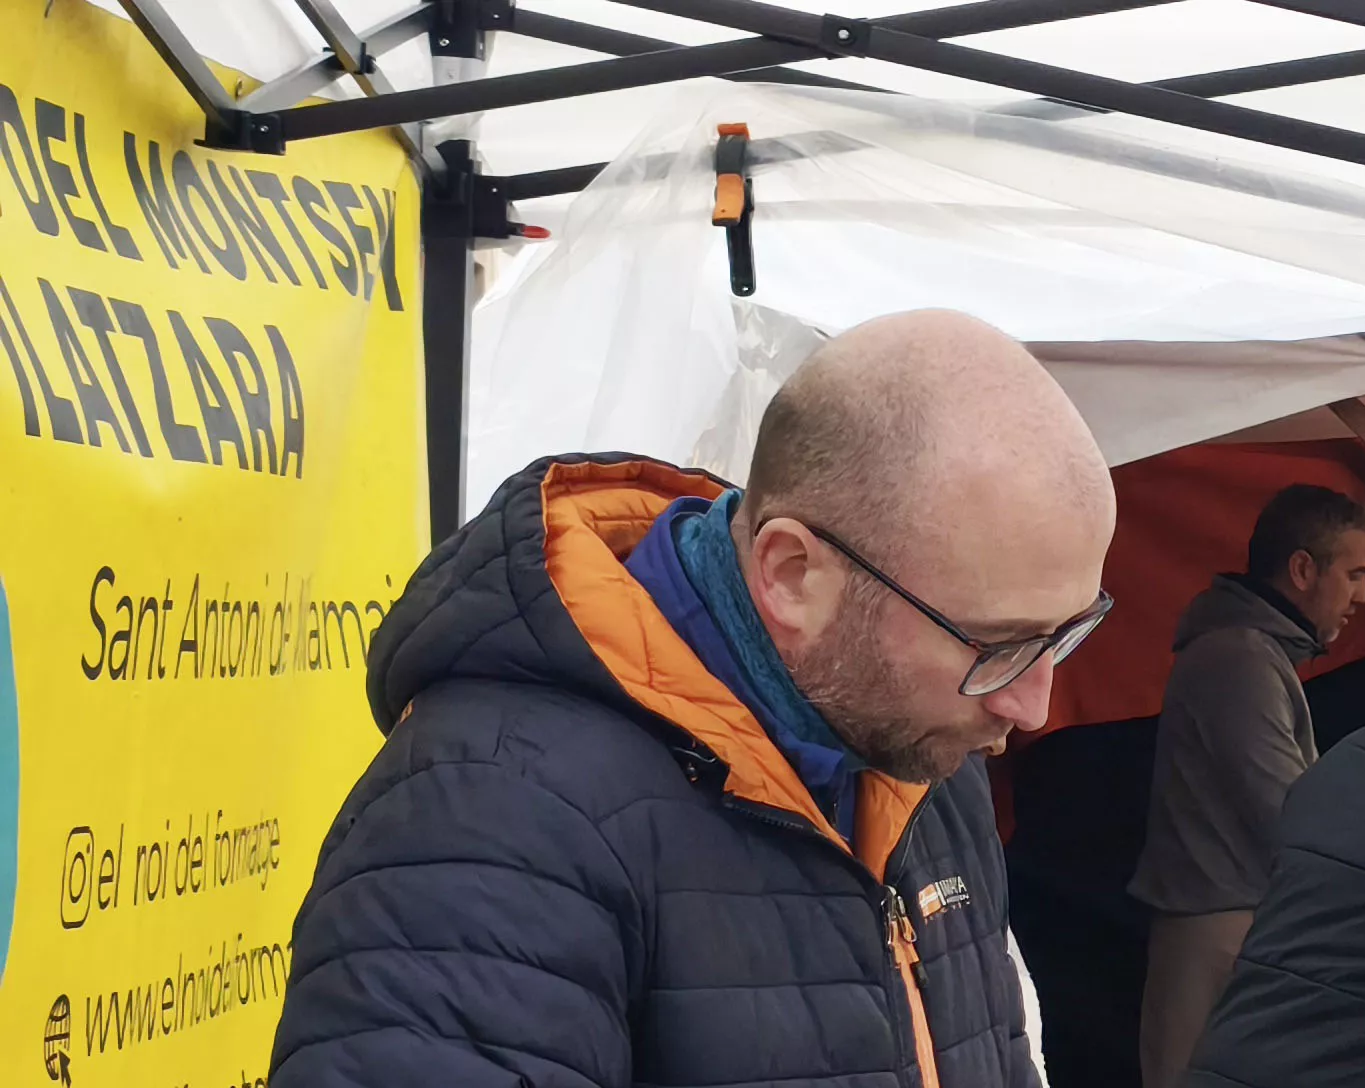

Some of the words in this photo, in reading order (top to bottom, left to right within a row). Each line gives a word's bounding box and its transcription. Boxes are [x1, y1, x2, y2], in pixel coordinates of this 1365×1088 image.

[0, 83, 143, 262] DEL
[81, 565, 173, 681] Sant
[174, 572, 269, 680] Antoni
[97, 823, 124, 911] el
[133, 819, 170, 906] noi
[174, 812, 209, 896] del
